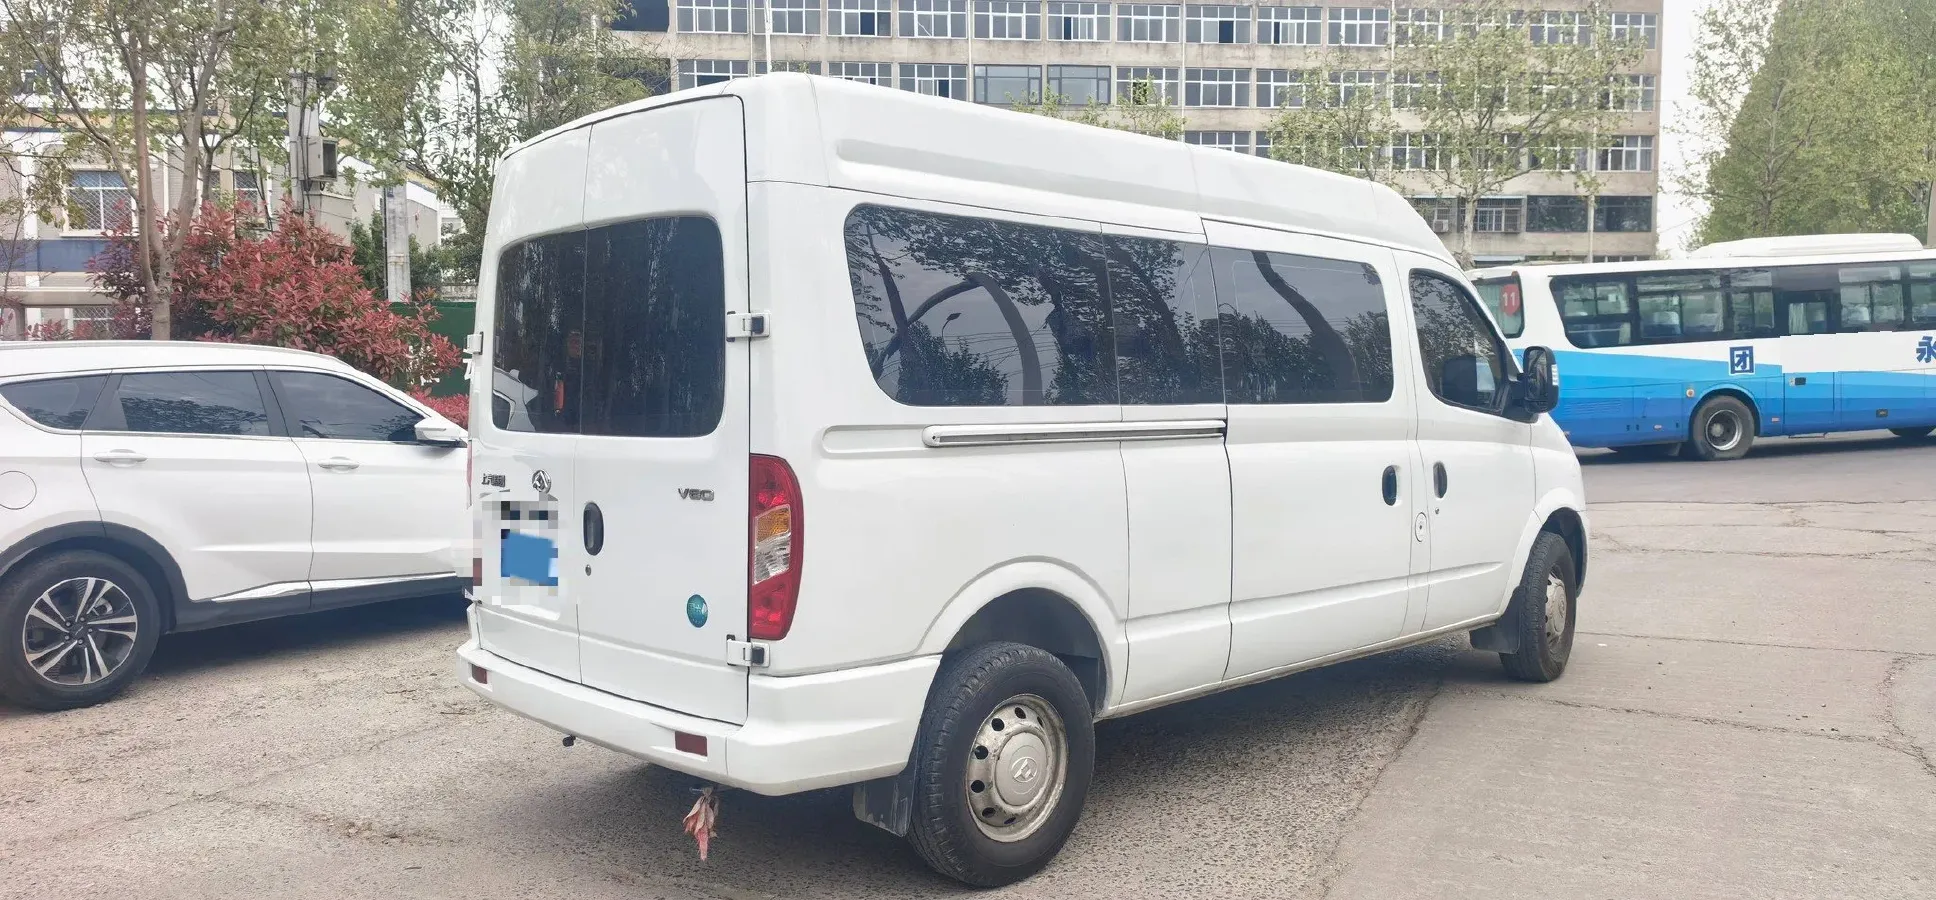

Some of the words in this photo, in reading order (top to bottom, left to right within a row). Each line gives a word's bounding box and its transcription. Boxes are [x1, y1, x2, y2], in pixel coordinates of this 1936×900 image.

[1502, 291, 1516, 307] 11
[1729, 345, 1754, 375] 团
[1916, 335, 1936, 364] 永
